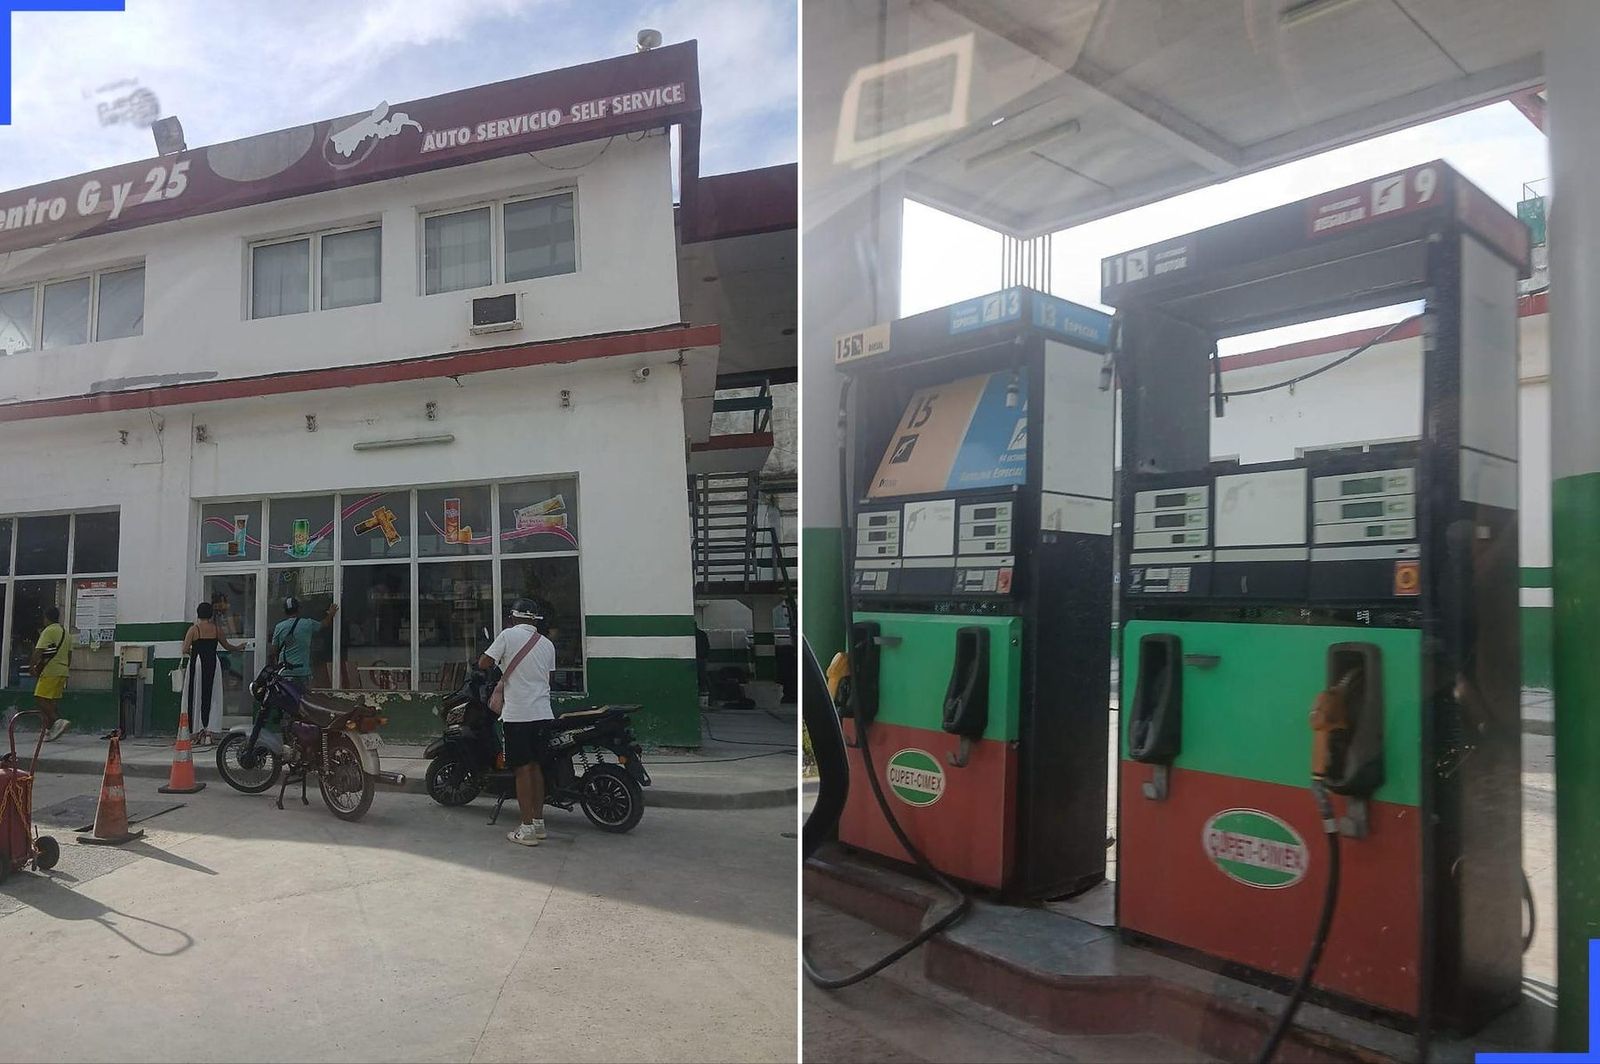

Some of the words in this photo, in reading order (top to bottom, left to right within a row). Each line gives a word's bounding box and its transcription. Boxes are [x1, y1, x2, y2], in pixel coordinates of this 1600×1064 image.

[423, 127, 470, 151] AUTO
[476, 110, 561, 141] SERVICIO
[571, 100, 607, 122] SELF
[613, 85, 682, 114] SERVICE
[77, 180, 101, 216] G
[106, 181, 133, 220] y
[142, 160, 192, 202] 25
[1413, 168, 1437, 204] 9
[1001, 290, 1020, 317] 13
[1041, 302, 1057, 328] 13
[837, 337, 851, 359] 15
[907, 392, 940, 429] 15
[890, 767, 942, 792] CUPET-CIMEX
